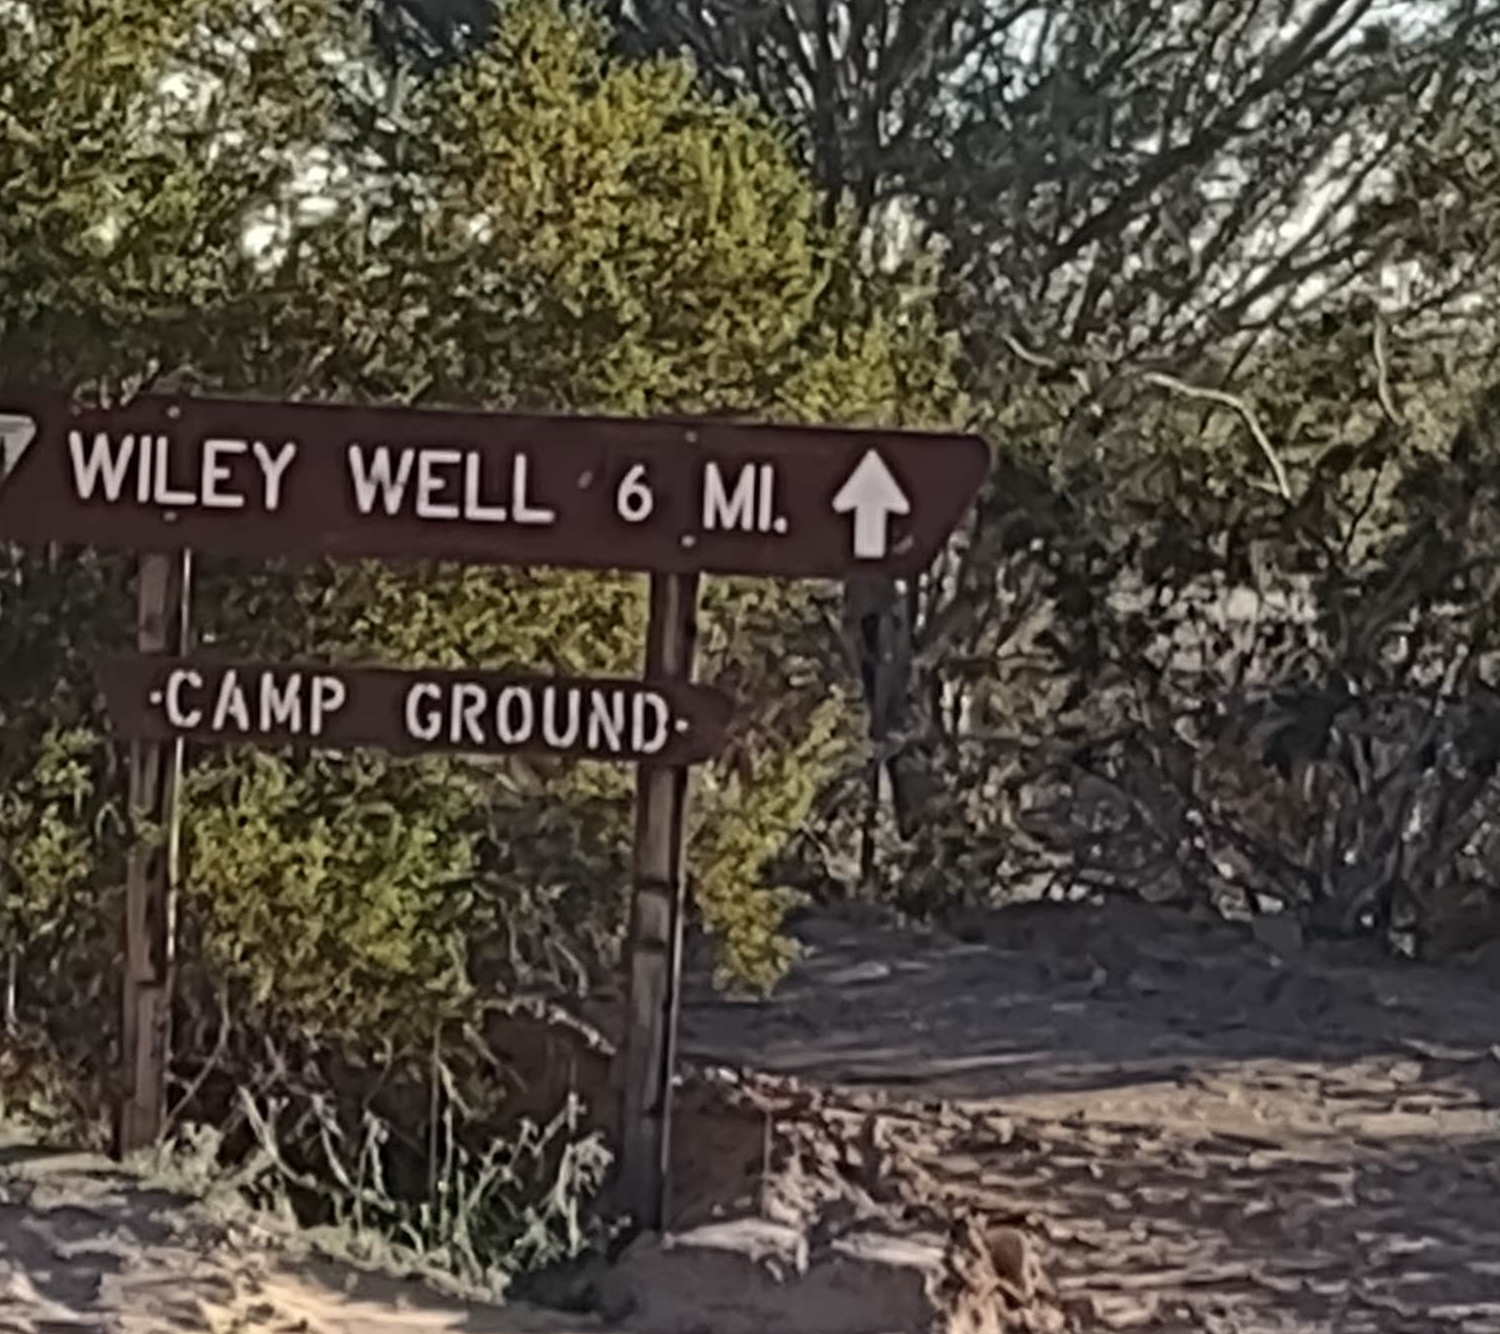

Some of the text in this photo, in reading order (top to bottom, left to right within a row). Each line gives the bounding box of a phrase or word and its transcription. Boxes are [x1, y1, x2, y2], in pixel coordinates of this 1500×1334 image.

[68, 430, 788, 534] WILEY WELL 6 MI.
[164, 669, 670, 754] CAMP GROUND
